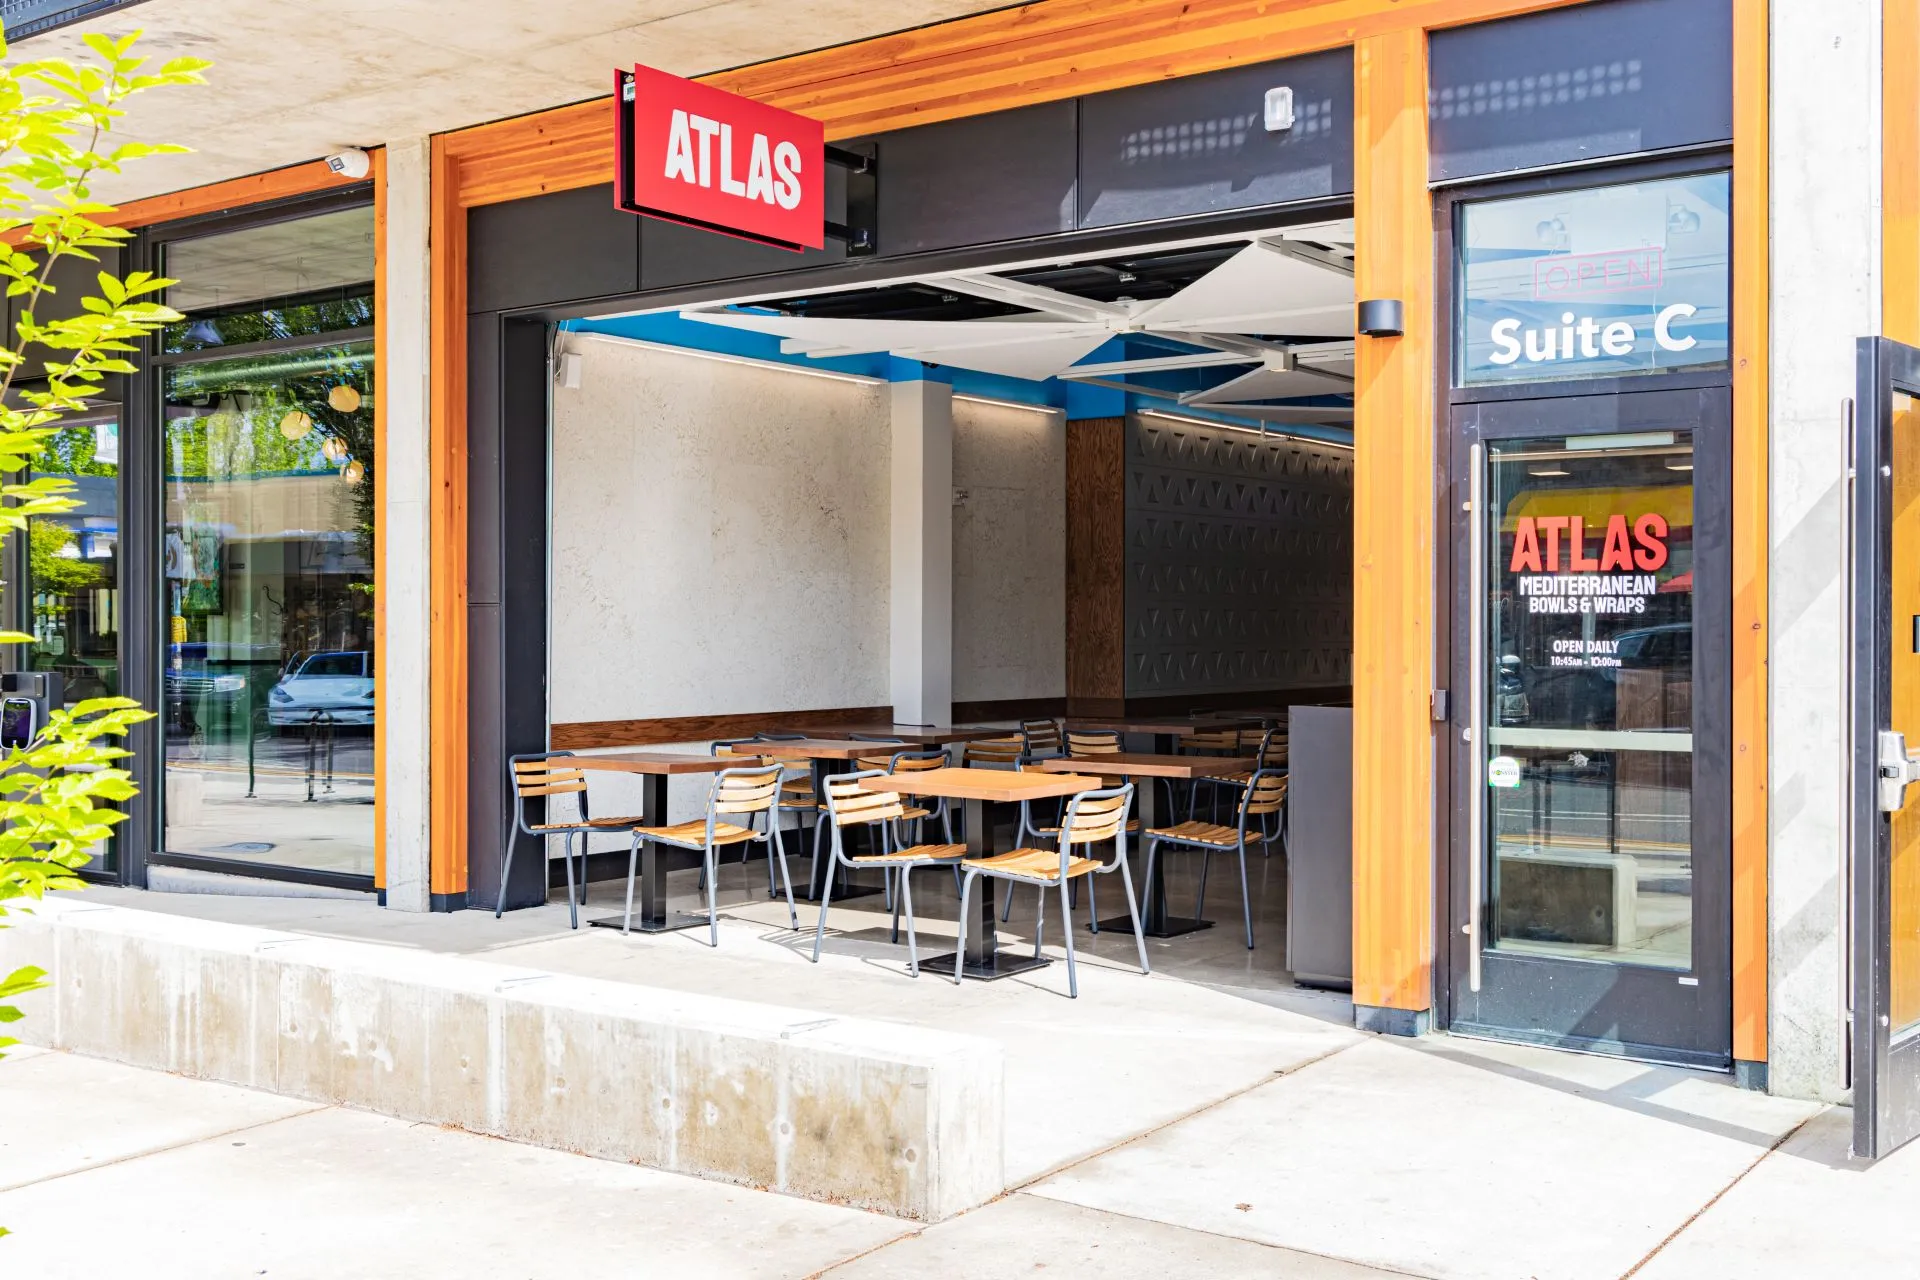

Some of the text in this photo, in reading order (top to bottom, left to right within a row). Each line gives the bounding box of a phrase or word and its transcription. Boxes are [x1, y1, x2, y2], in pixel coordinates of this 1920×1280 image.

[664, 108, 802, 210] ATLAS
[1544, 254, 1652, 290] OPEN
[1489, 303, 1698, 365] Suite C
[1510, 513, 1668, 572] ATLAS
[1519, 576, 1656, 595] MEDITERRANEAN
[1529, 597, 1645, 613] BOWLS & WRAPS
[1553, 640, 1619, 653] OPEN DAILY
